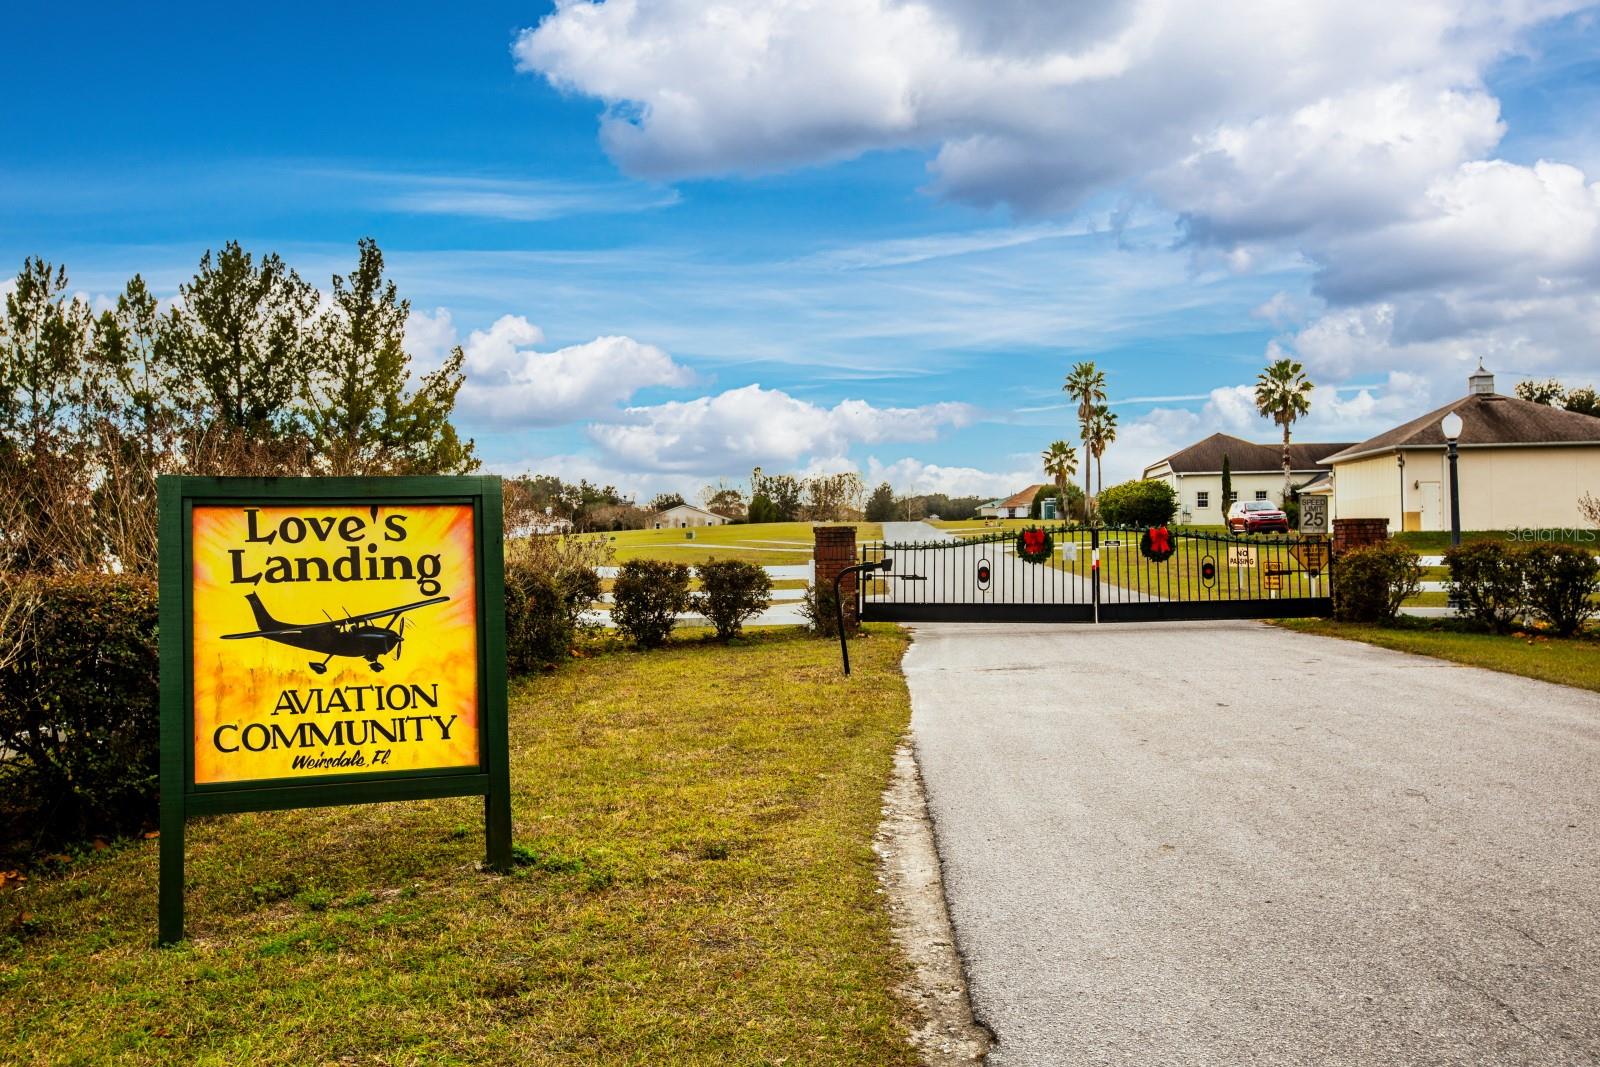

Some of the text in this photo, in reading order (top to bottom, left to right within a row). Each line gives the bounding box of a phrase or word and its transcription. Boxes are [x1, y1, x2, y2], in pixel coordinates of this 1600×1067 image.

[244, 504, 408, 546] Love's
[1303, 511, 1325, 527] 25
[227, 543, 442, 597] Landing
[271, 683, 440, 716] AVIATION
[213, 714, 458, 753] COMMUNITY
[292, 750, 370, 770] Weirsdale,
